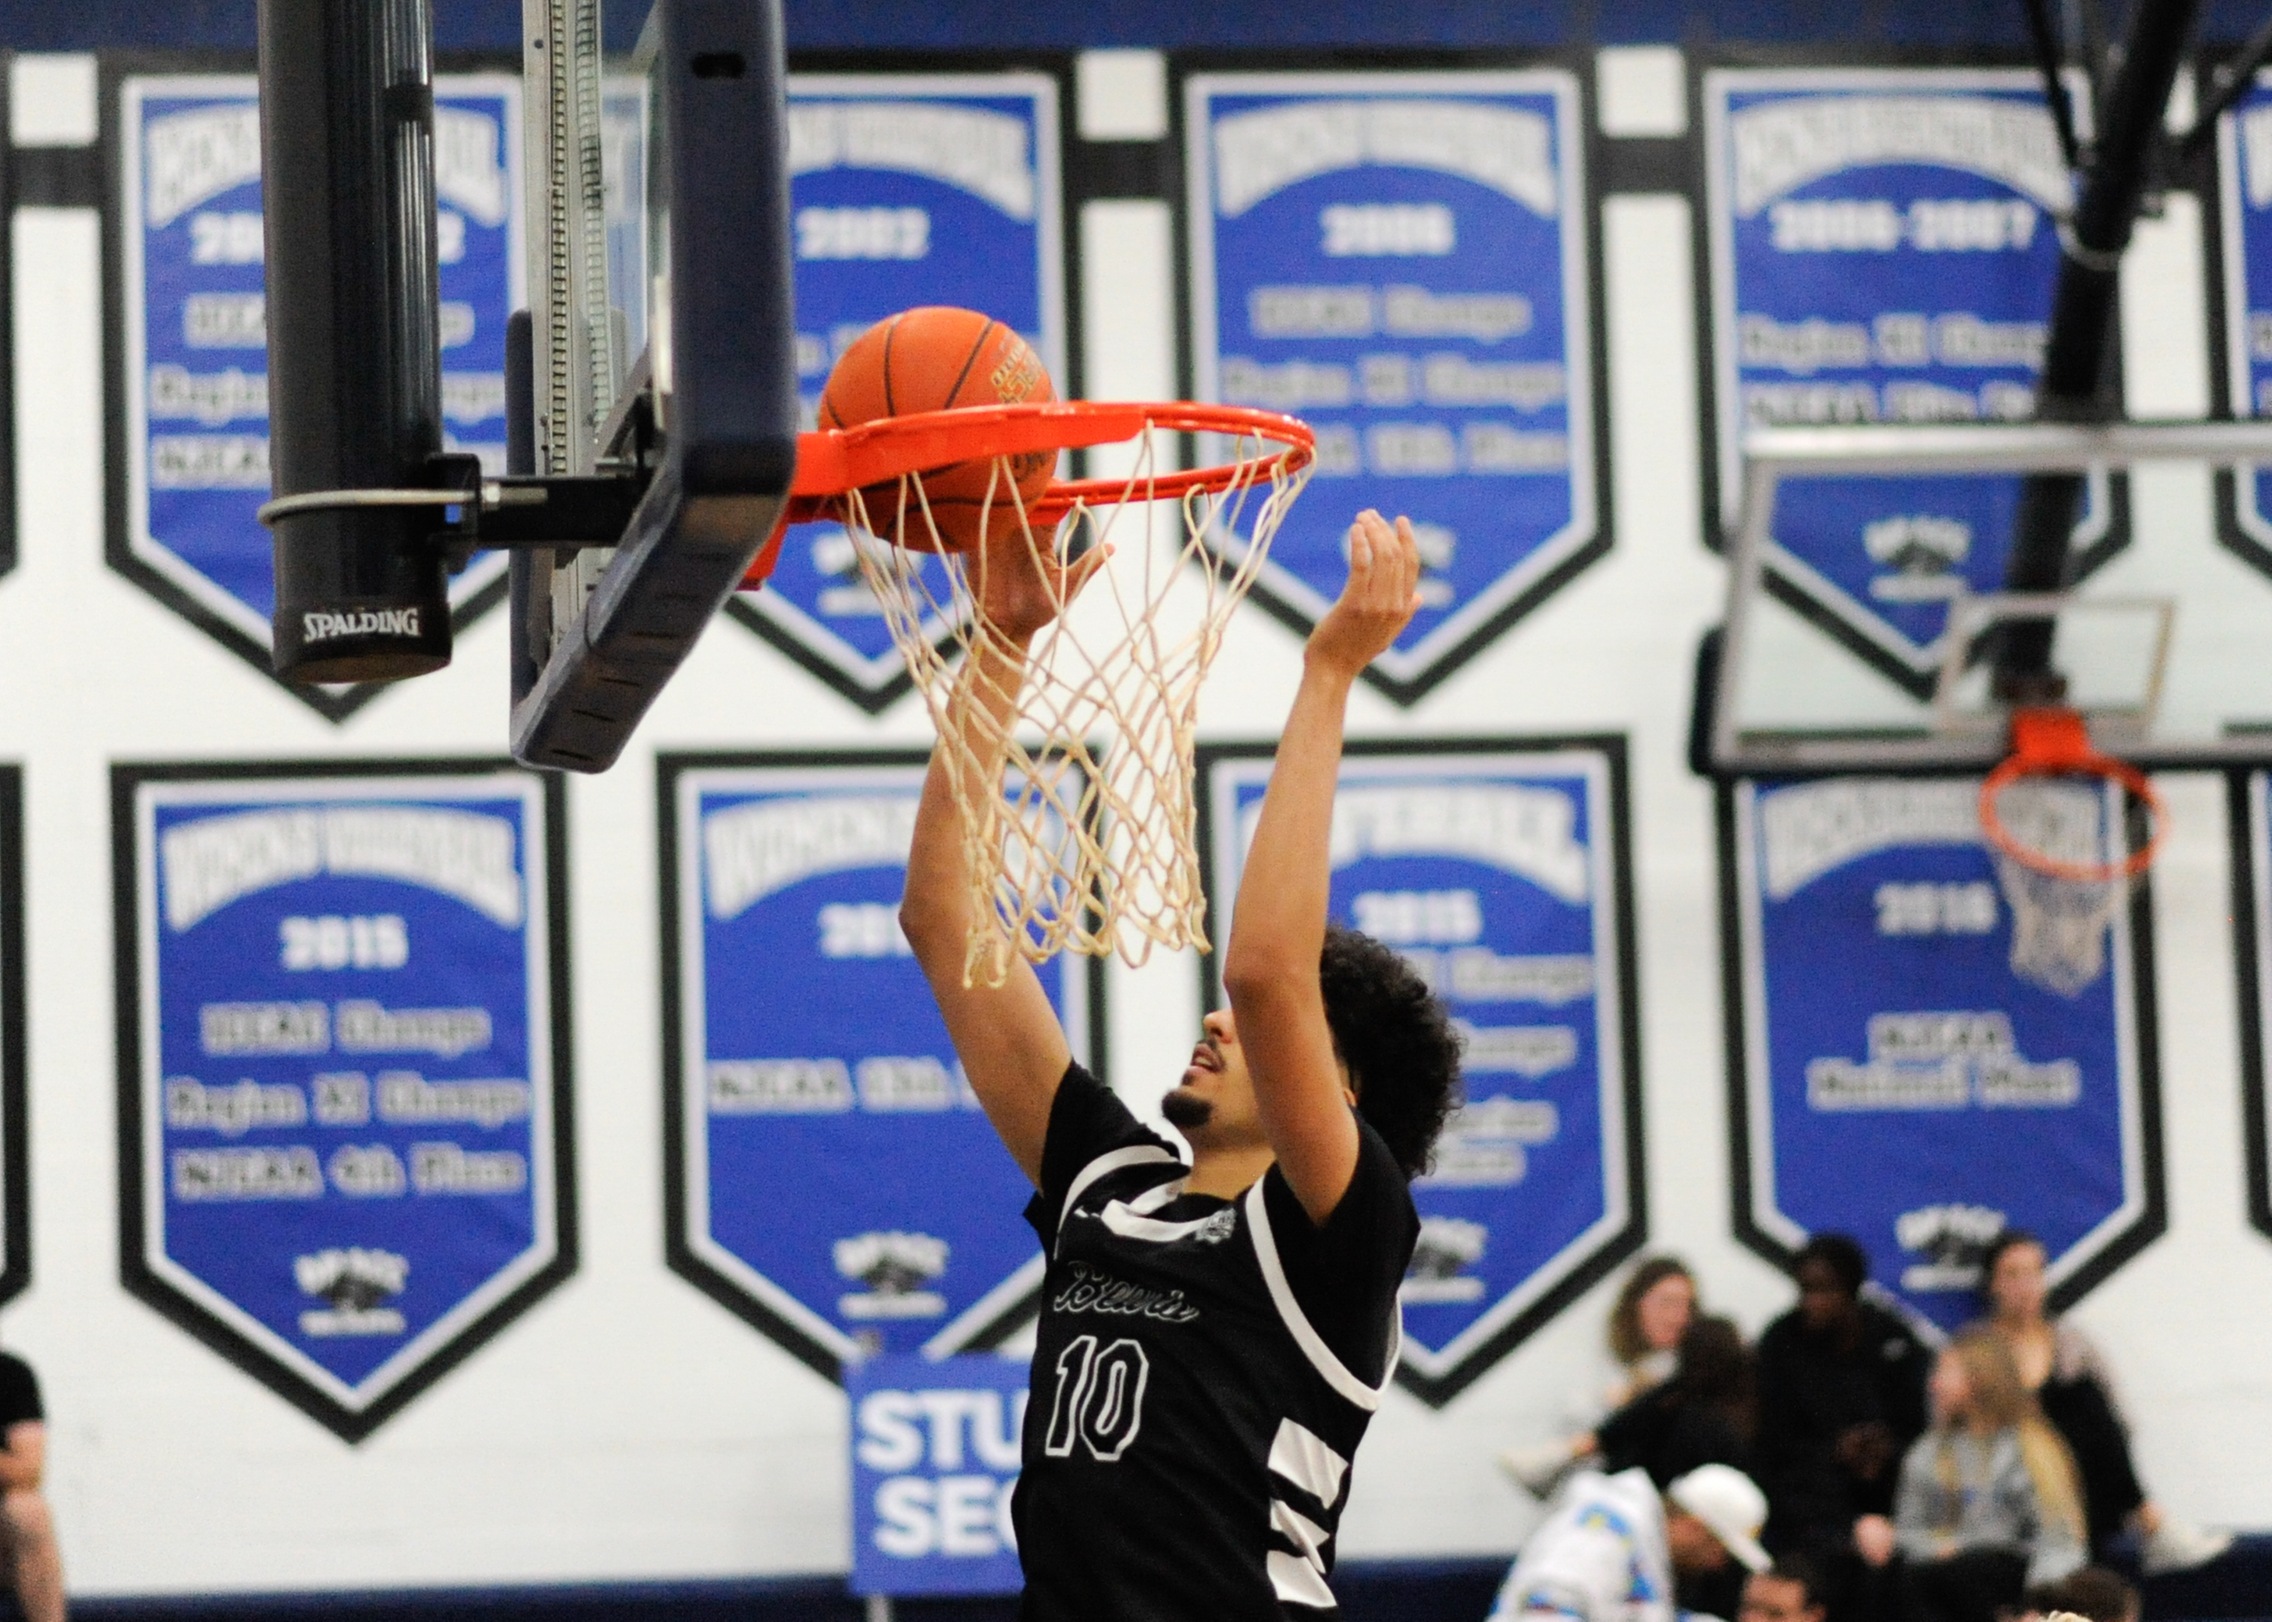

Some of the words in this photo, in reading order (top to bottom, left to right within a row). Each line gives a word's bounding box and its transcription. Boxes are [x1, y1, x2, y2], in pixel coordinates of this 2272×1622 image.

[304, 608, 421, 643] SPALDING
[1045, 1336, 1149, 1461] 10
[874, 1476, 1017, 1557] SE
